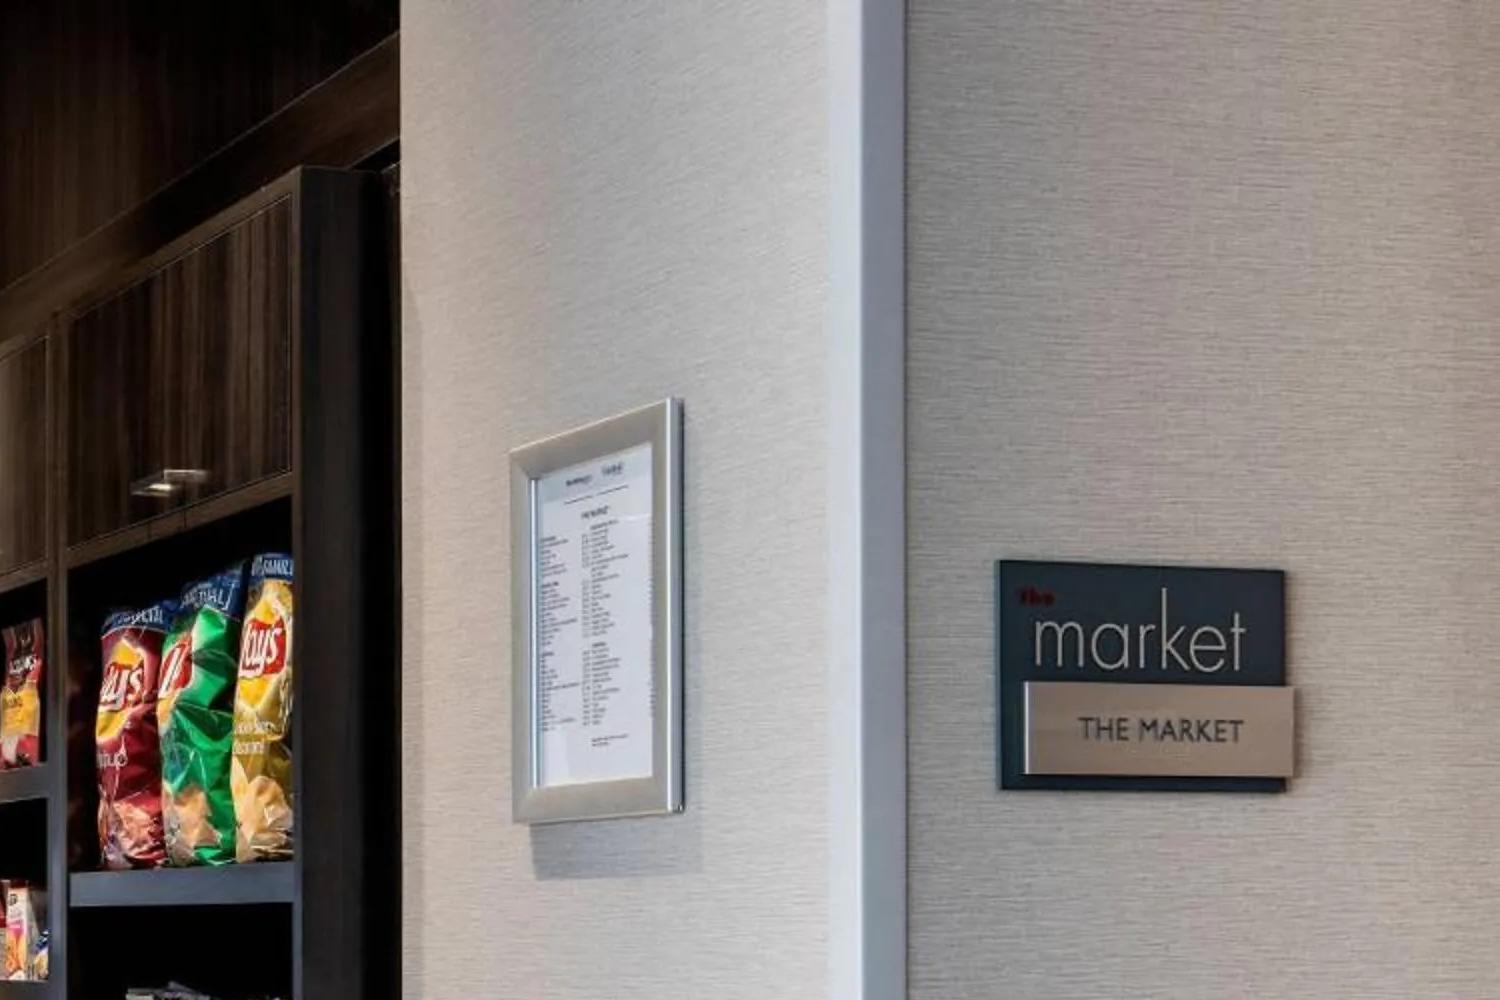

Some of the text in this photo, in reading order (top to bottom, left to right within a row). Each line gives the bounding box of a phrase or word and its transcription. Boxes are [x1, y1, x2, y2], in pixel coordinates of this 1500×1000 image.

[1034, 587, 1247, 673] market
[1077, 716, 1245, 743] THE MARKET
